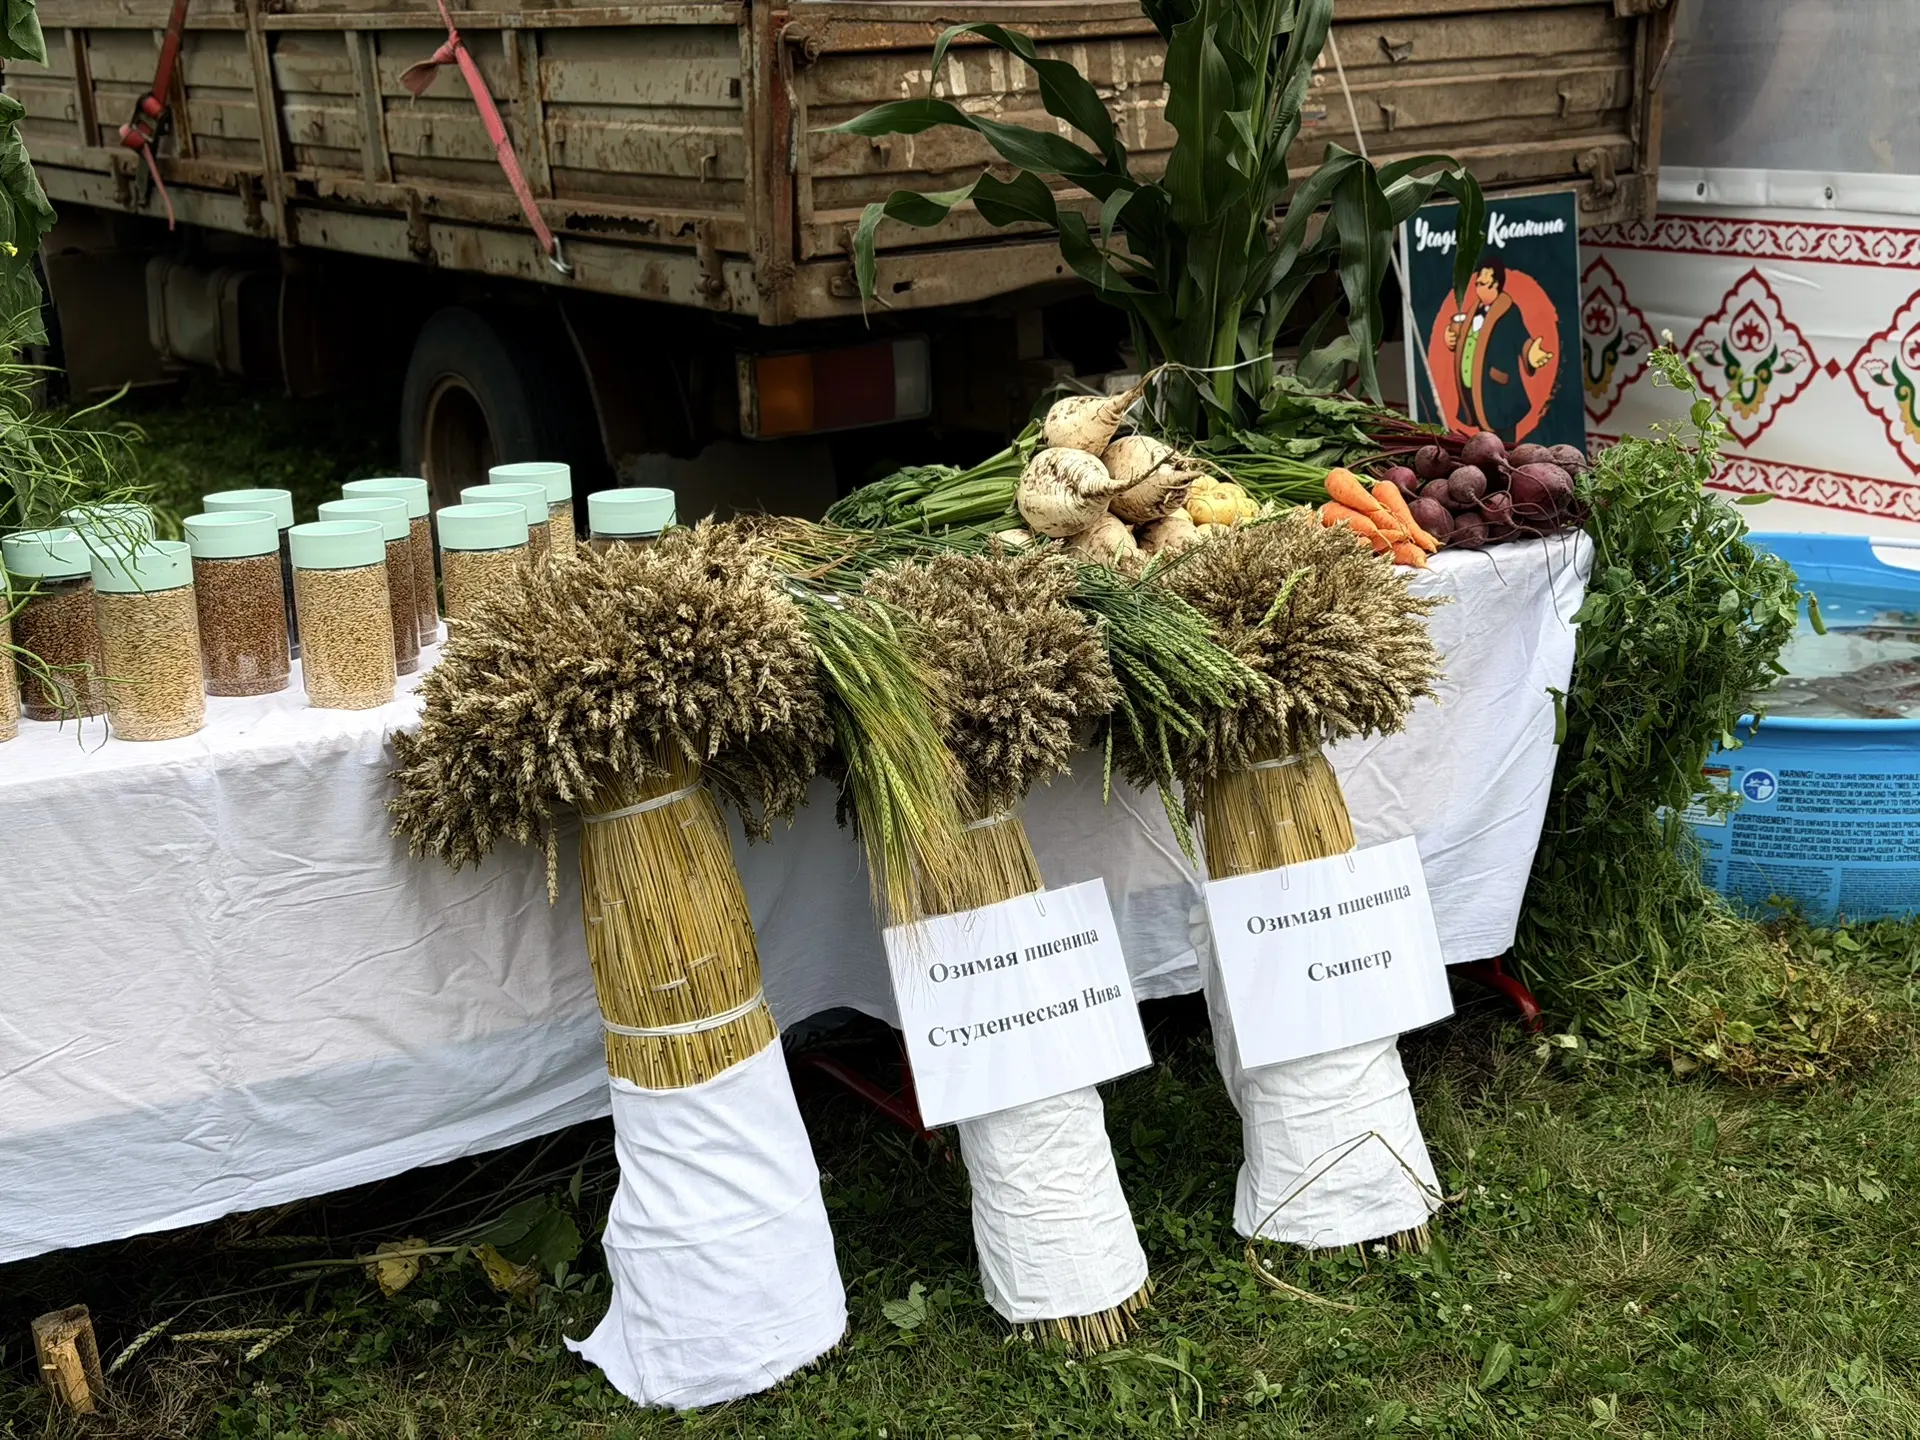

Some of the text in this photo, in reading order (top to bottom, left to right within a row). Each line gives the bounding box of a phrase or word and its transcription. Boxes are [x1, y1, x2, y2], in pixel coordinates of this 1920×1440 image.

[1415, 211, 1566, 254] Усад Касакина
[1779, 770, 1814, 778] WARNING!
[1815, 772, 1841, 780] CHILDREN
[1806, 789, 1846, 797] UNSUPERVISED
[1776, 804, 1794, 812] LOCAL
[1774, 835, 1814, 843] SURVEILLANCE
[1731, 848, 1763, 856] CONSULTEZ
[1247, 884, 1412, 934] Озимая пшеница
[929, 928, 1099, 983] Озимая пшеница
[1308, 950, 1392, 982] Скипетр
[928, 984, 1122, 1047] Студенческая Нива
